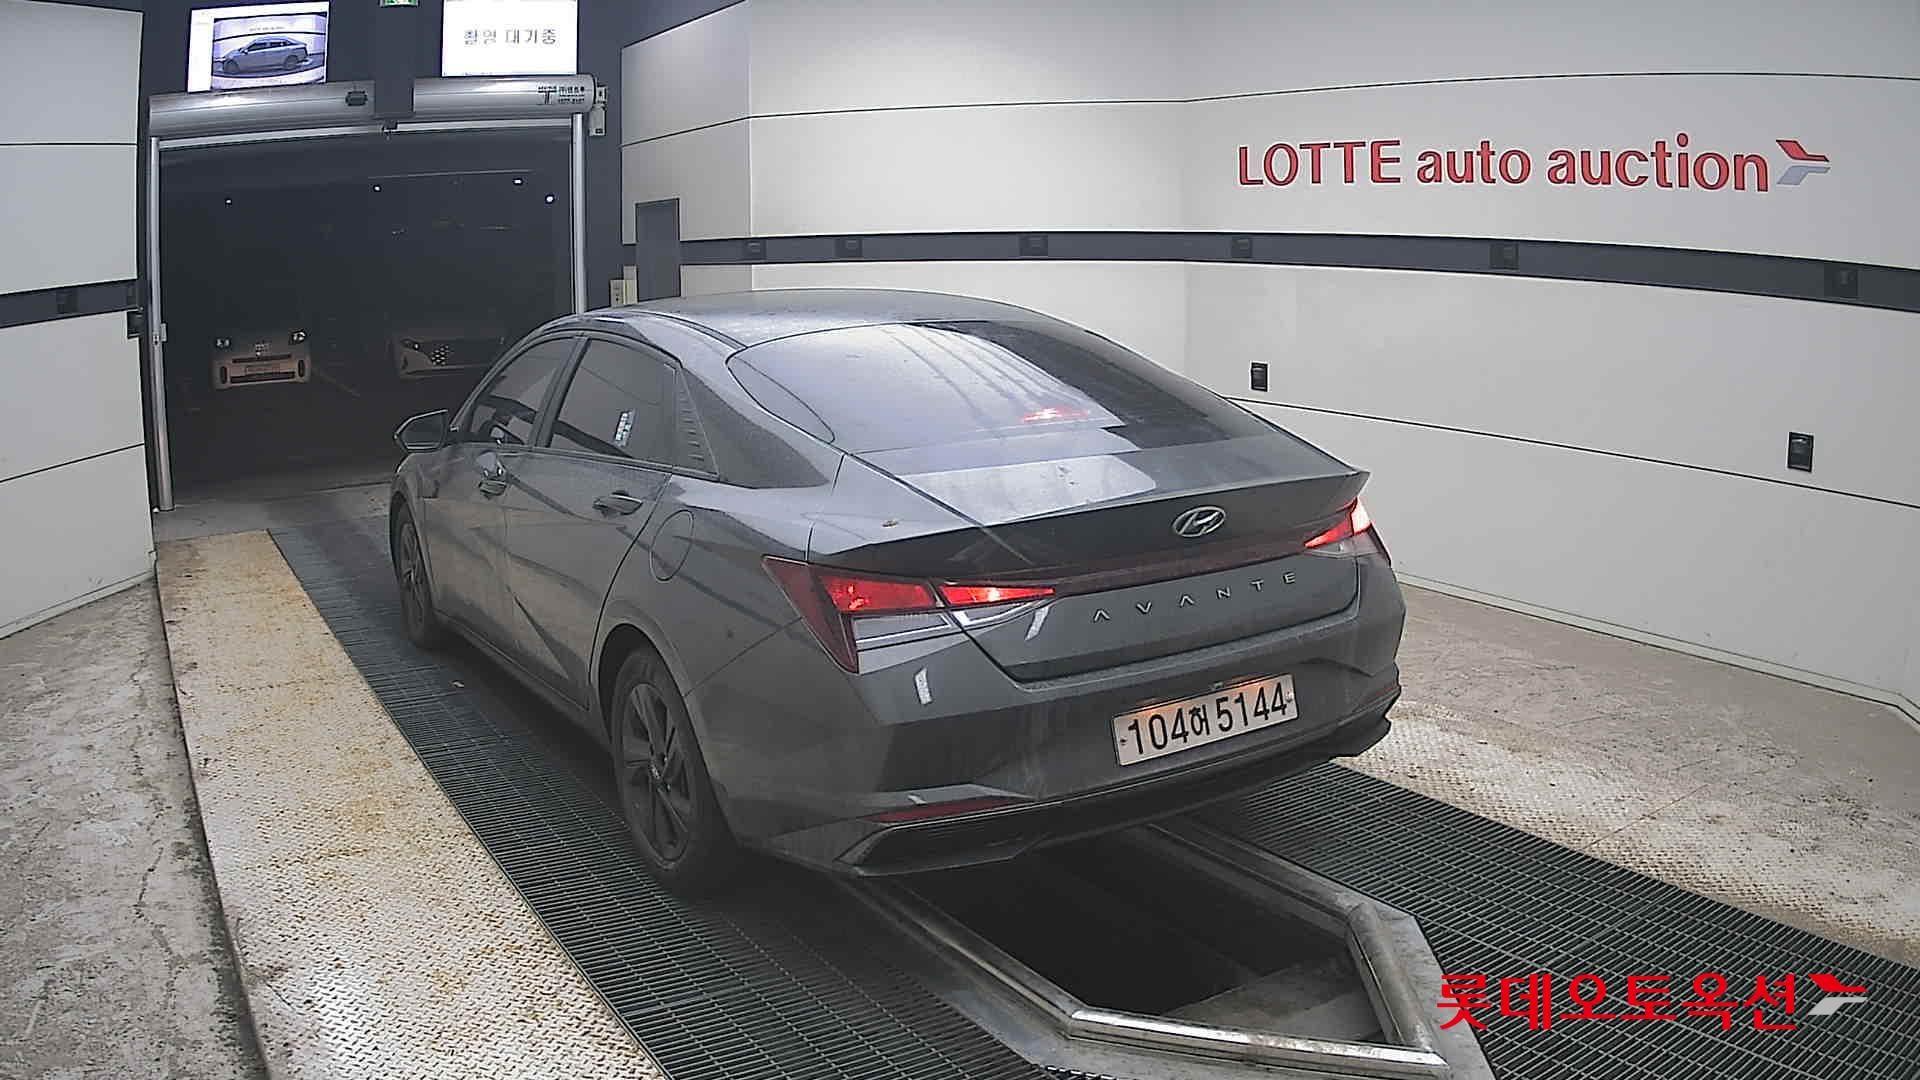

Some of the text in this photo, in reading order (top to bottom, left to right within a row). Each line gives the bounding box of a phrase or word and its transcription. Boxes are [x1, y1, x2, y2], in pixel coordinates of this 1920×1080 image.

[1239, 132, 1769, 192] LOTTE auto auction
[1092, 572, 1297, 623] AVANTE
